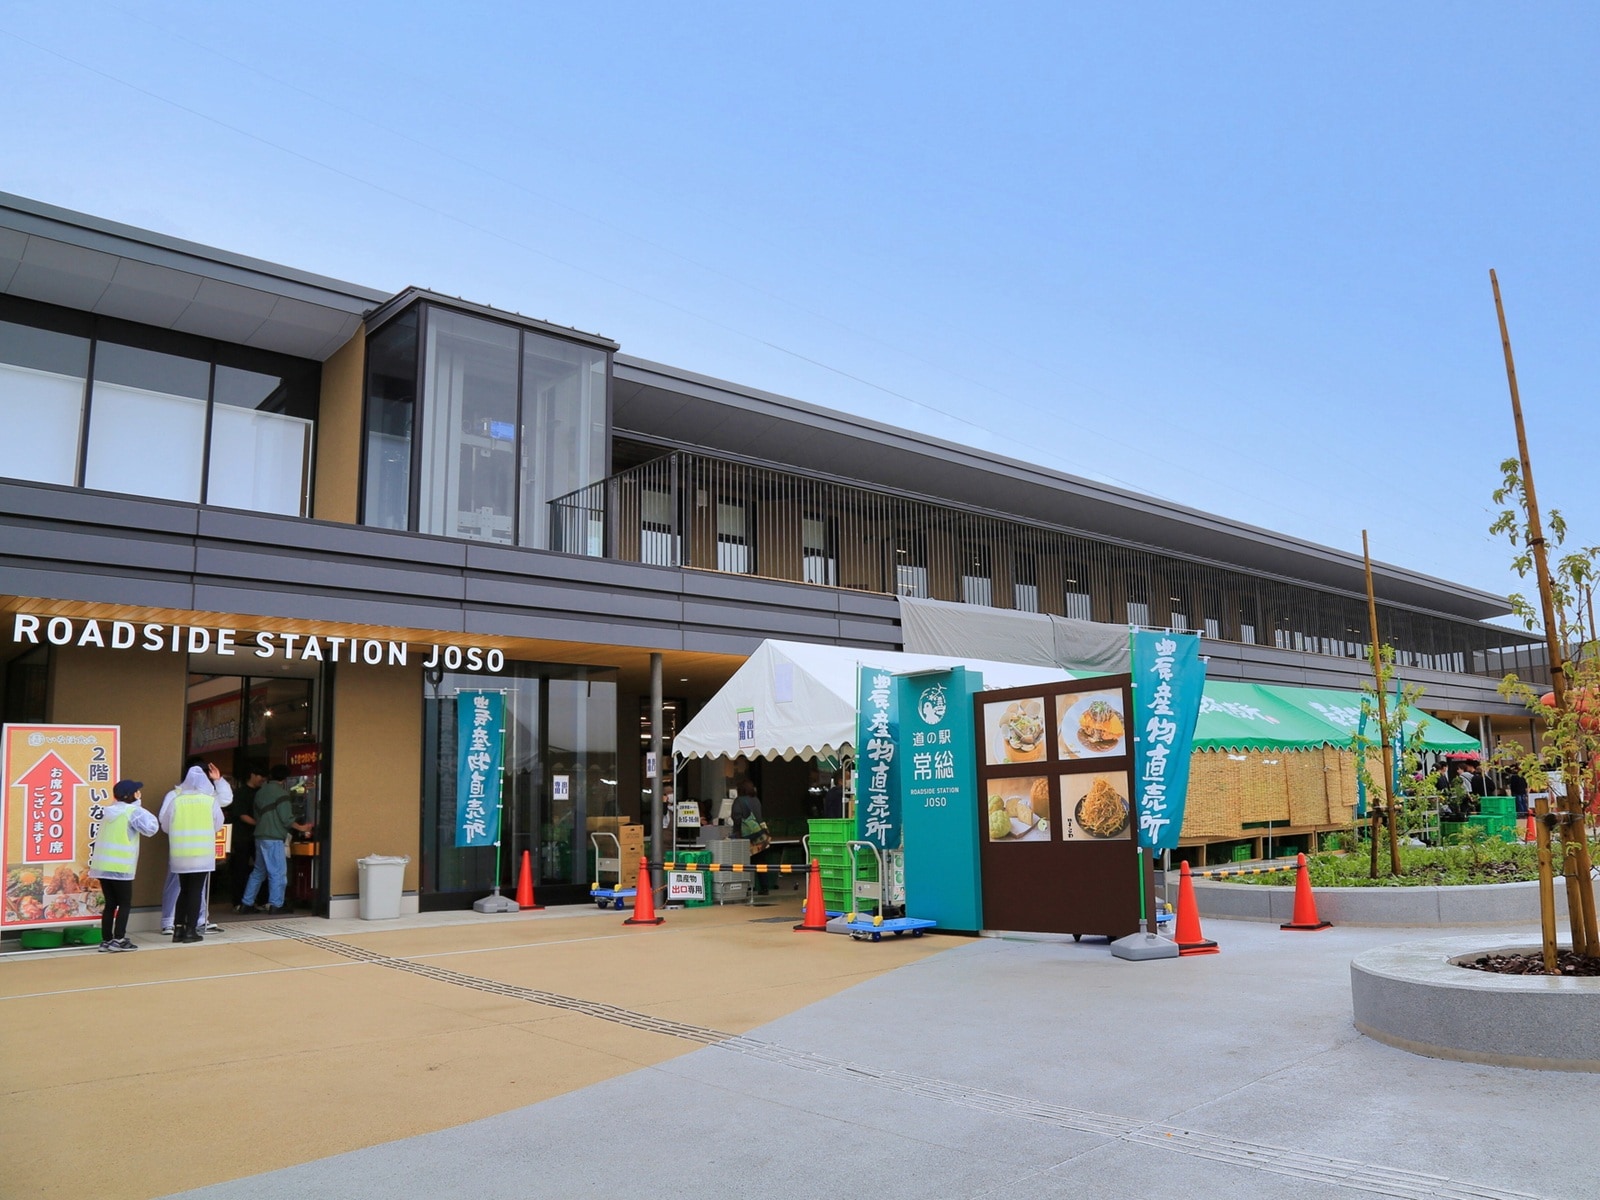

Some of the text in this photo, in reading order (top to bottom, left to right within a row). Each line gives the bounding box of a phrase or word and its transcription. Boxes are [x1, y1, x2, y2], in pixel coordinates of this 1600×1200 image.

[13, 613, 504, 673] ROADSIDE STATION JOSO
[912, 729, 952, 747] 道の駅
[1139, 638, 1177, 845] 農産物直売所
[89, 746, 109, 781] 2階
[865, 674, 895, 847] 農産物直売所
[913, 750, 955, 781] 常総
[910, 787, 960, 796] ROADSIDE STATION
[924, 797, 947, 808] JOSO
[48, 767, 64, 854] お席200席
[671, 885, 703, 895] 出口専用
